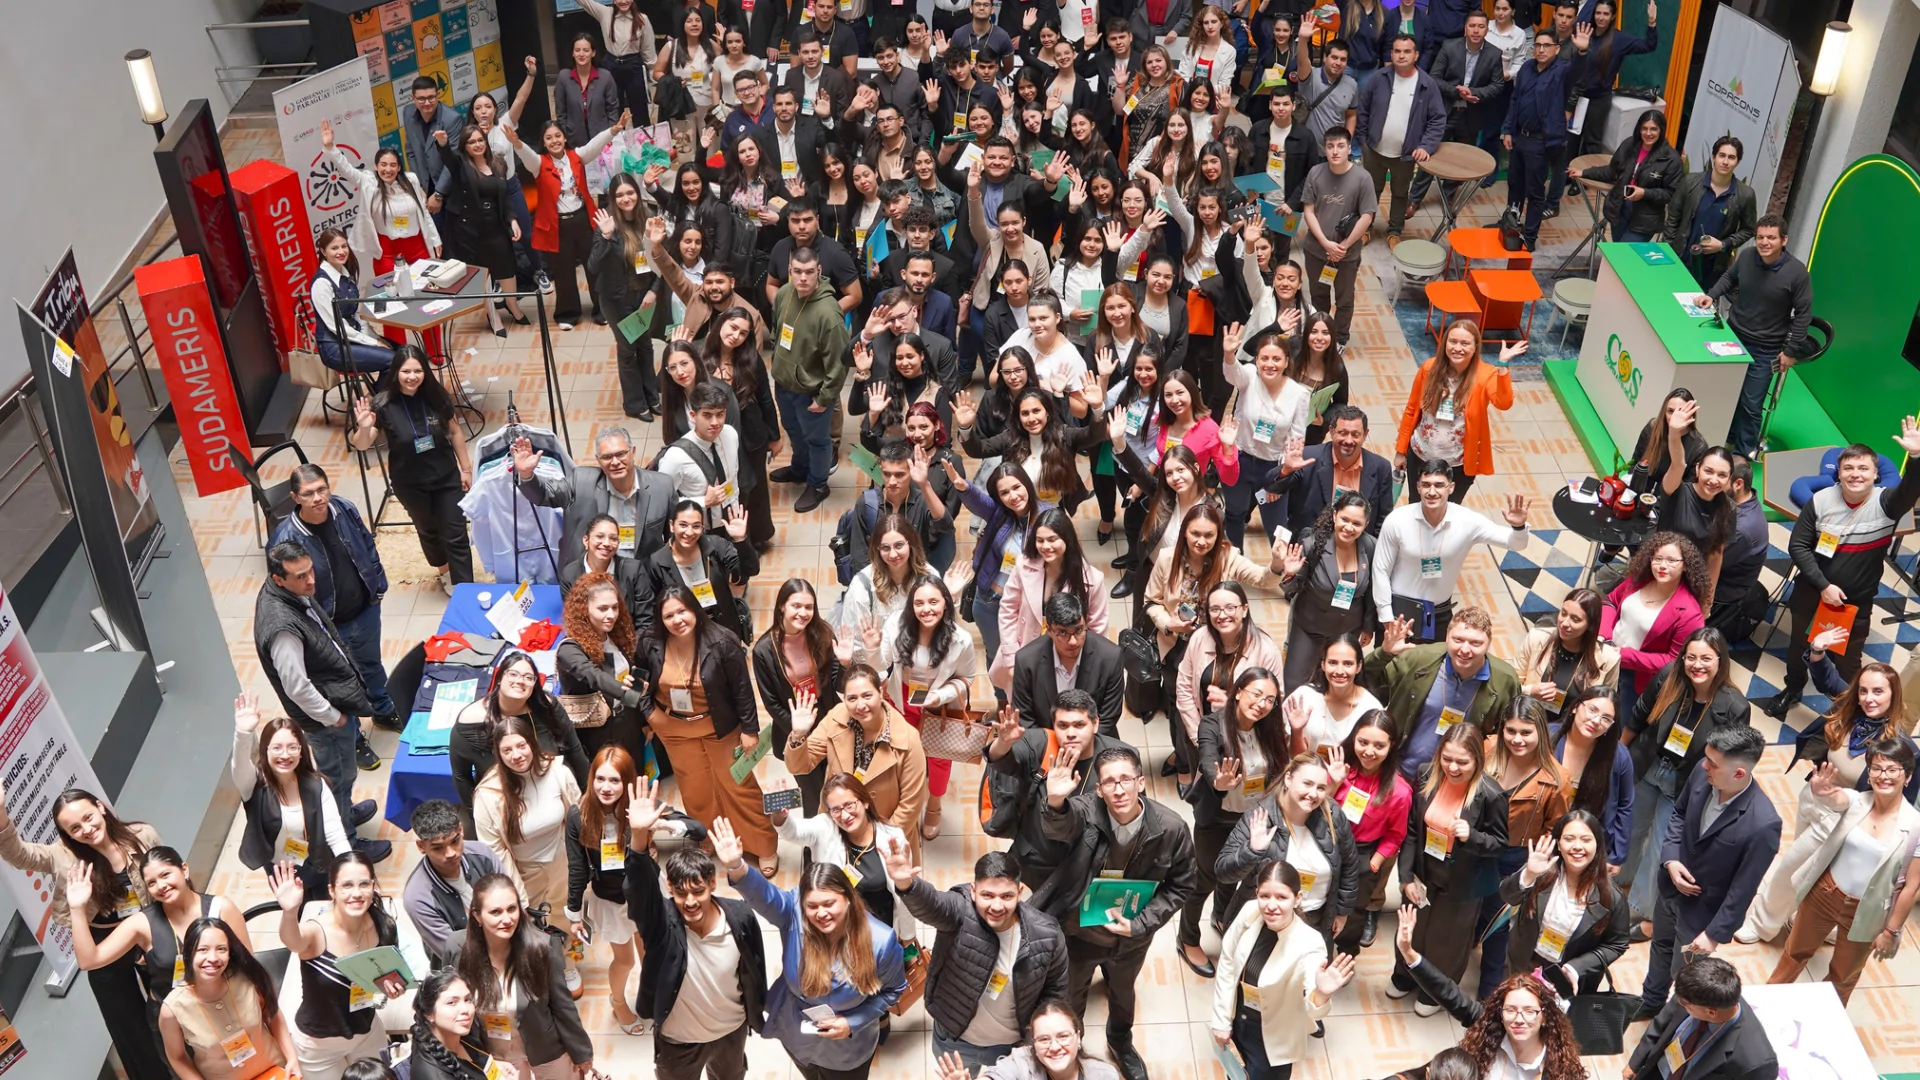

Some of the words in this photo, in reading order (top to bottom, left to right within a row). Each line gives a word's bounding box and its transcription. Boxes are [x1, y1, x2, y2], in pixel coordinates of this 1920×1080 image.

[296, 90, 324, 104] GOBIERNO
[296, 92, 330, 111] PARAGUAY
[1708, 80, 1760, 118] COPACONS
[270, 196, 315, 351] DAMERIS
[167, 307, 235, 473] SUDAMERIS
[2, 752, 30, 792] RVICIOS:
[6, 779, 28, 816] APERTURA
[26, 769, 34, 782] DE
[32, 737, 55, 773] EMPRESAS
[12, 774, 47, 828] ASESORAMIENTO
[46, 743, 68, 778] CONTABLE
[54, 926, 66, 944] 099
